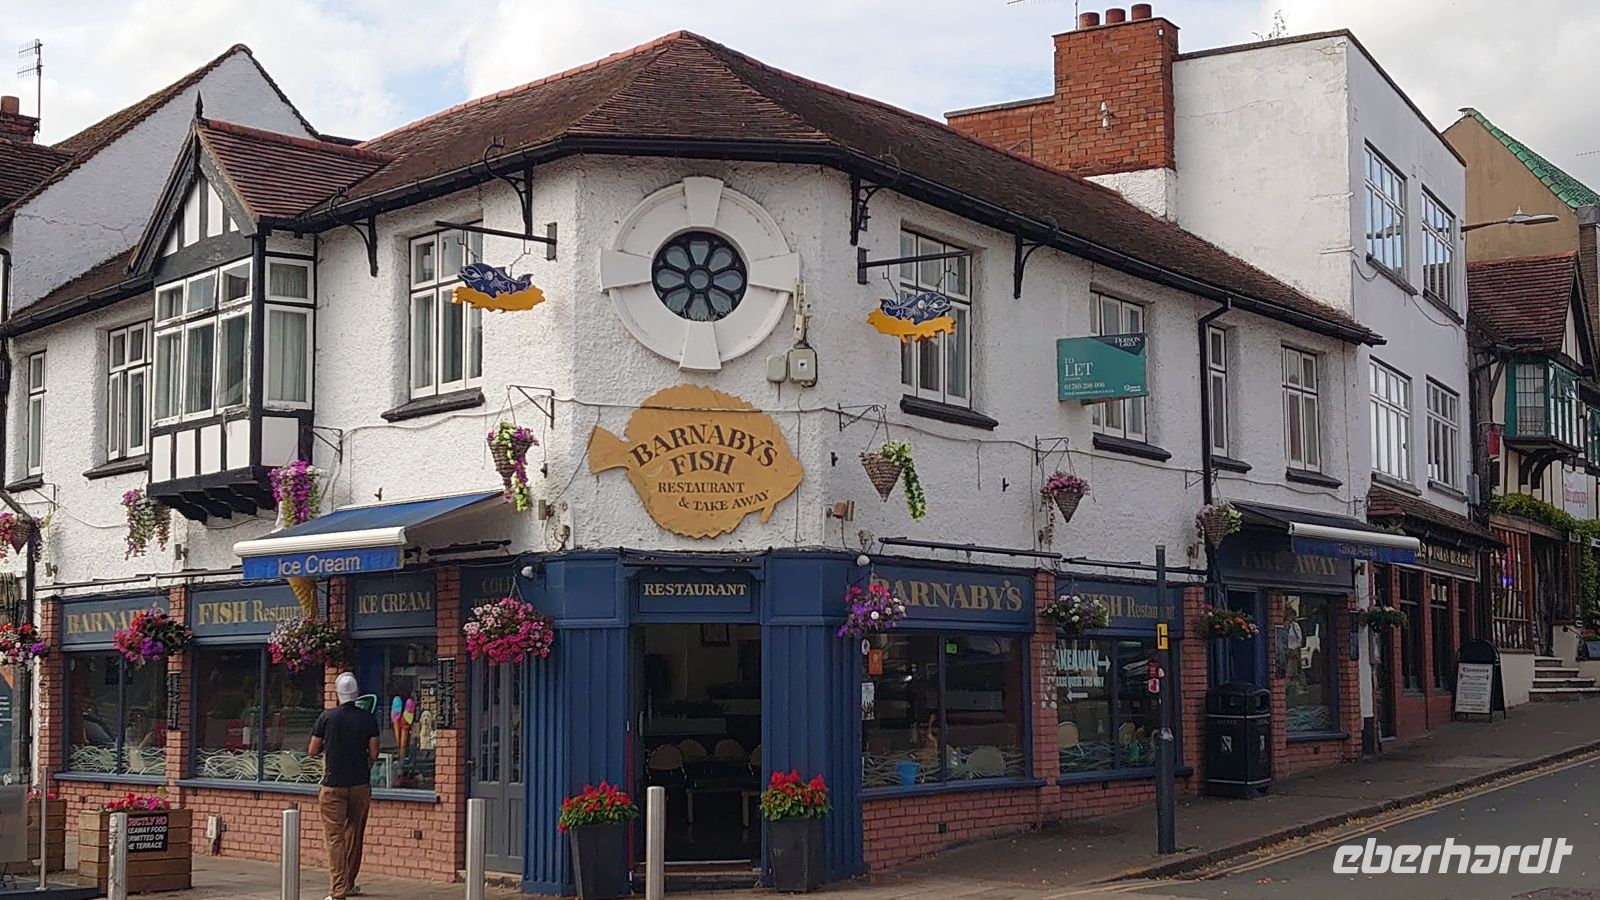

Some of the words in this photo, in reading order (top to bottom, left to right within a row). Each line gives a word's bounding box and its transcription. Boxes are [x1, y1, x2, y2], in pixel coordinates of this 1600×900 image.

[1065, 362, 1094, 377] LET
[629, 423, 778, 468] BARNABY'S
[670, 450, 737, 478] FISH
[658, 482, 745, 494] RESTAURANT
[678, 496, 690, 509] &
[693, 500, 728, 512] TAKE
[732, 489, 769, 509] AWAY
[278, 558, 301, 576] Ice
[305, 554, 360, 574] Cream
[1295, 554, 1336, 577] AWAY
[643, 582, 749, 597] RESTAURANT
[198, 600, 248, 626] FISH
[357, 595, 377, 614] ICE
[380, 591, 430, 613] CREAM
[1126, 596, 1175, 620] Restaunt
[1055, 649, 1099, 672] AKEAWAY
[155, 816, 168, 826] NO
[136, 842, 163, 850] TERRACE
